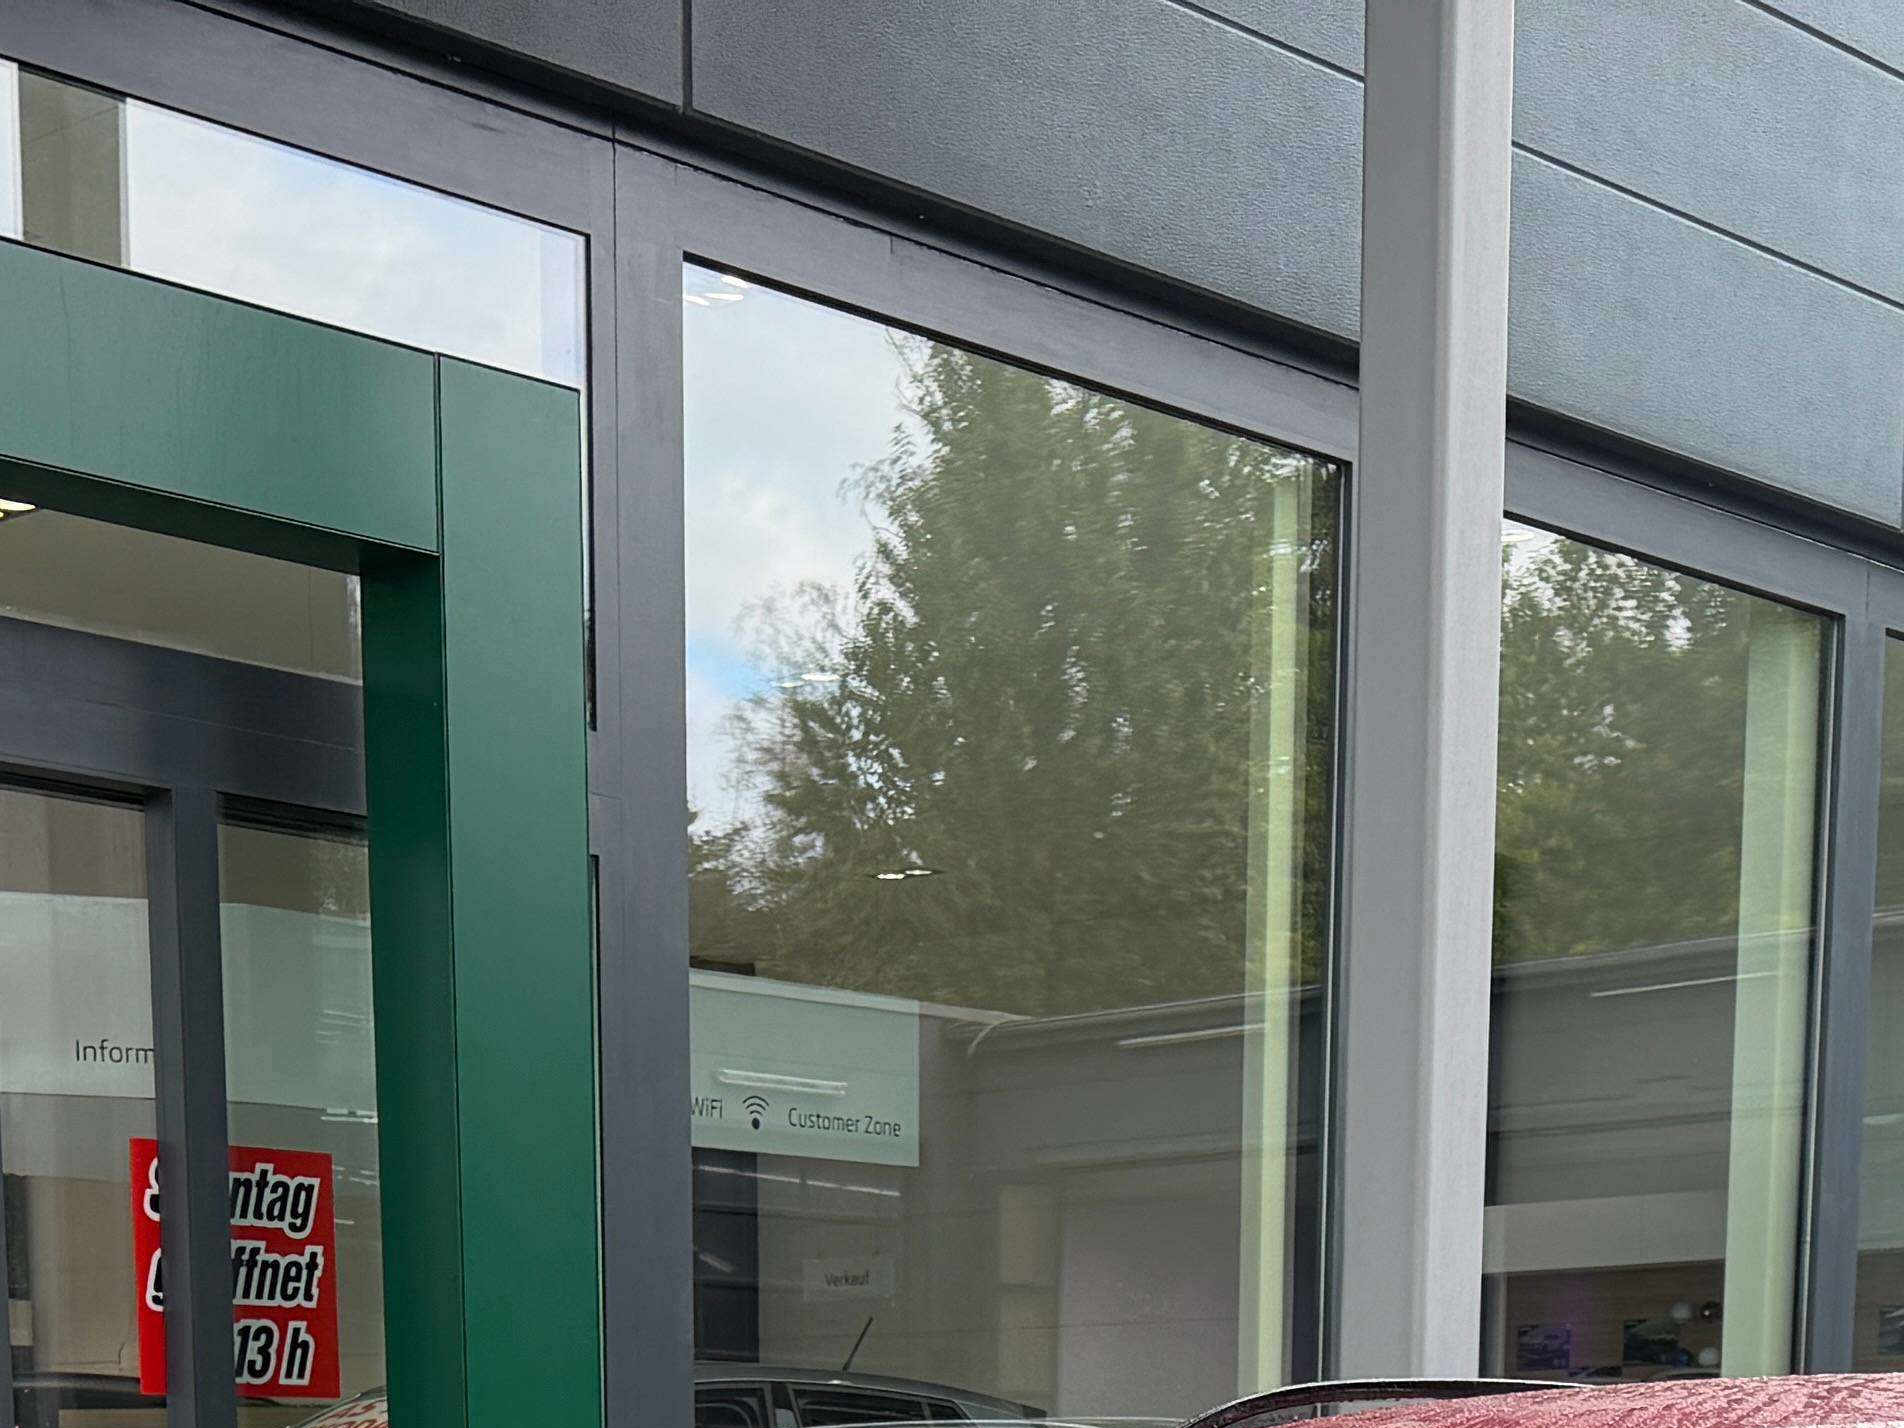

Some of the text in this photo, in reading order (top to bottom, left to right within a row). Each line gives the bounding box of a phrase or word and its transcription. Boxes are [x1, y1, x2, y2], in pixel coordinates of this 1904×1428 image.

[76, 1039, 155, 1064] Inform
[788, 1107, 861, 1133] Customer
[864, 1115, 901, 1138] Zone
[824, 1269, 870, 1288] Verkauf
[279, 1321, 315, 1386] h
